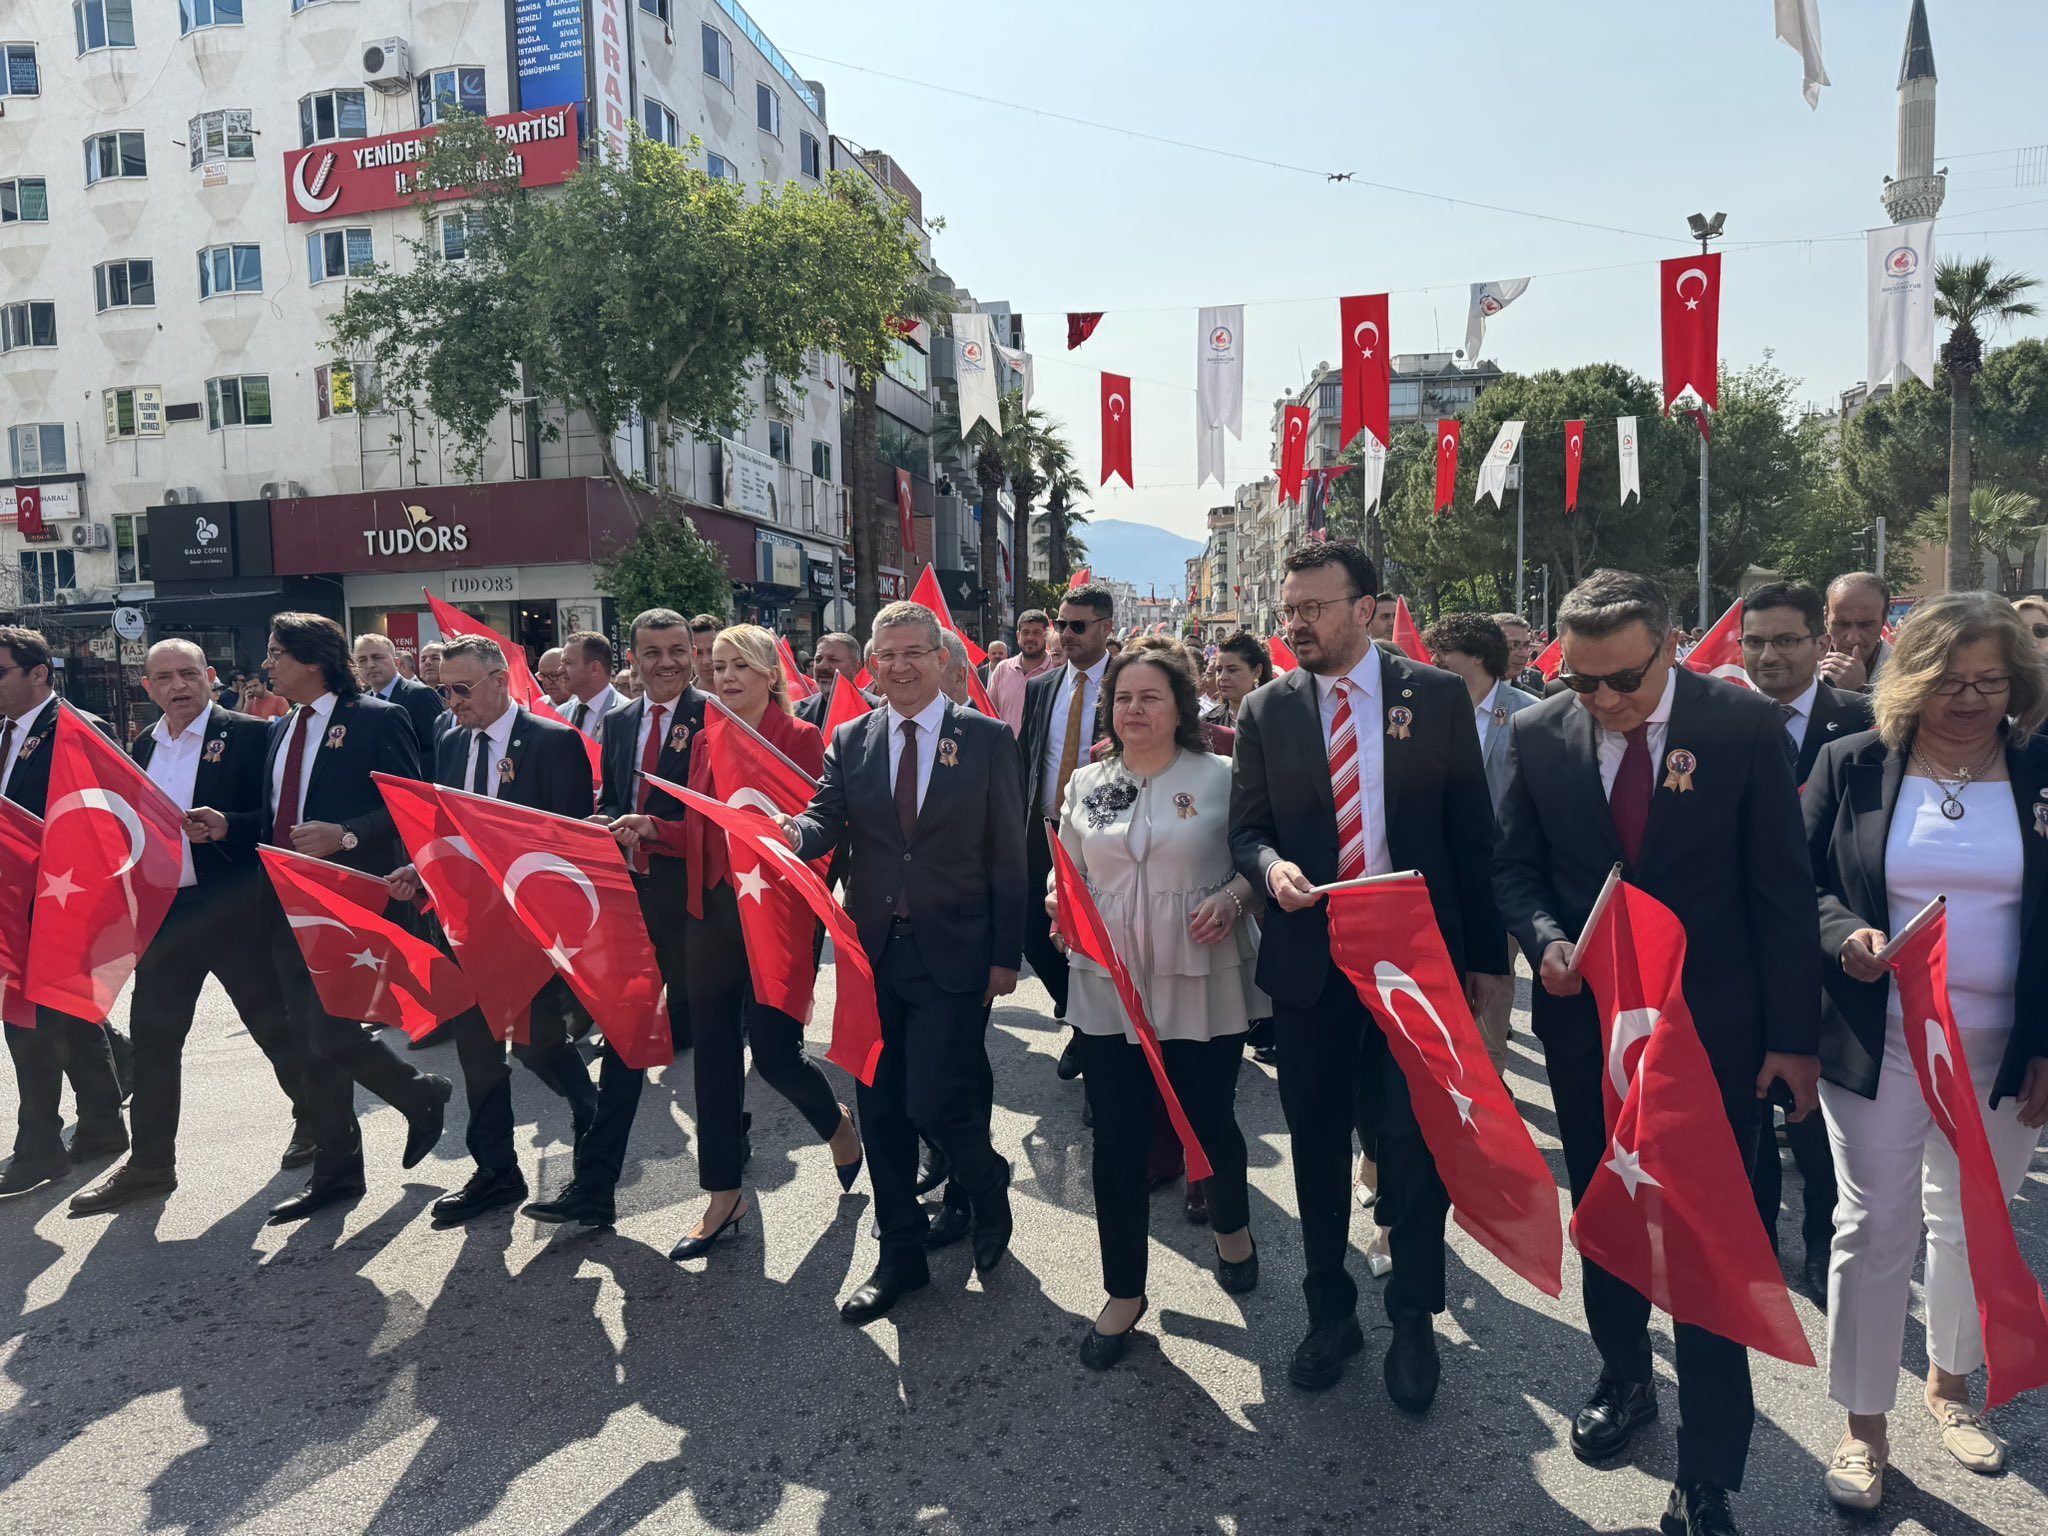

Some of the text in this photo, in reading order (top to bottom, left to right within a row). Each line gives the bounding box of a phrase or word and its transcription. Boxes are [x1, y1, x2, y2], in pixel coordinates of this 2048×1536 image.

[516, 2, 541, 13] MANİSA
[516, 6, 580, 24] DENİZLİ ANKARA
[517, 17, 581, 35] AYDIN ANTALYA
[517, 28, 579, 45] MUĞLA SİVAS
[518, 39, 582, 56] İSTANBUL AFYON
[518, 50, 582, 67] UŞAK ERZİNCAN
[519, 63, 561, 77] GÜMÜŞHANE
[495, 111, 566, 146] PARTİSİ
[144, 393, 153, 401] CEP
[363, 524, 468, 556] TUDORS
[761, 532, 783, 546] SULTAN
[451, 576, 513, 593] TUDORS
[878, 576, 894, 596] ING
[394, 636, 413, 645] YENİ
